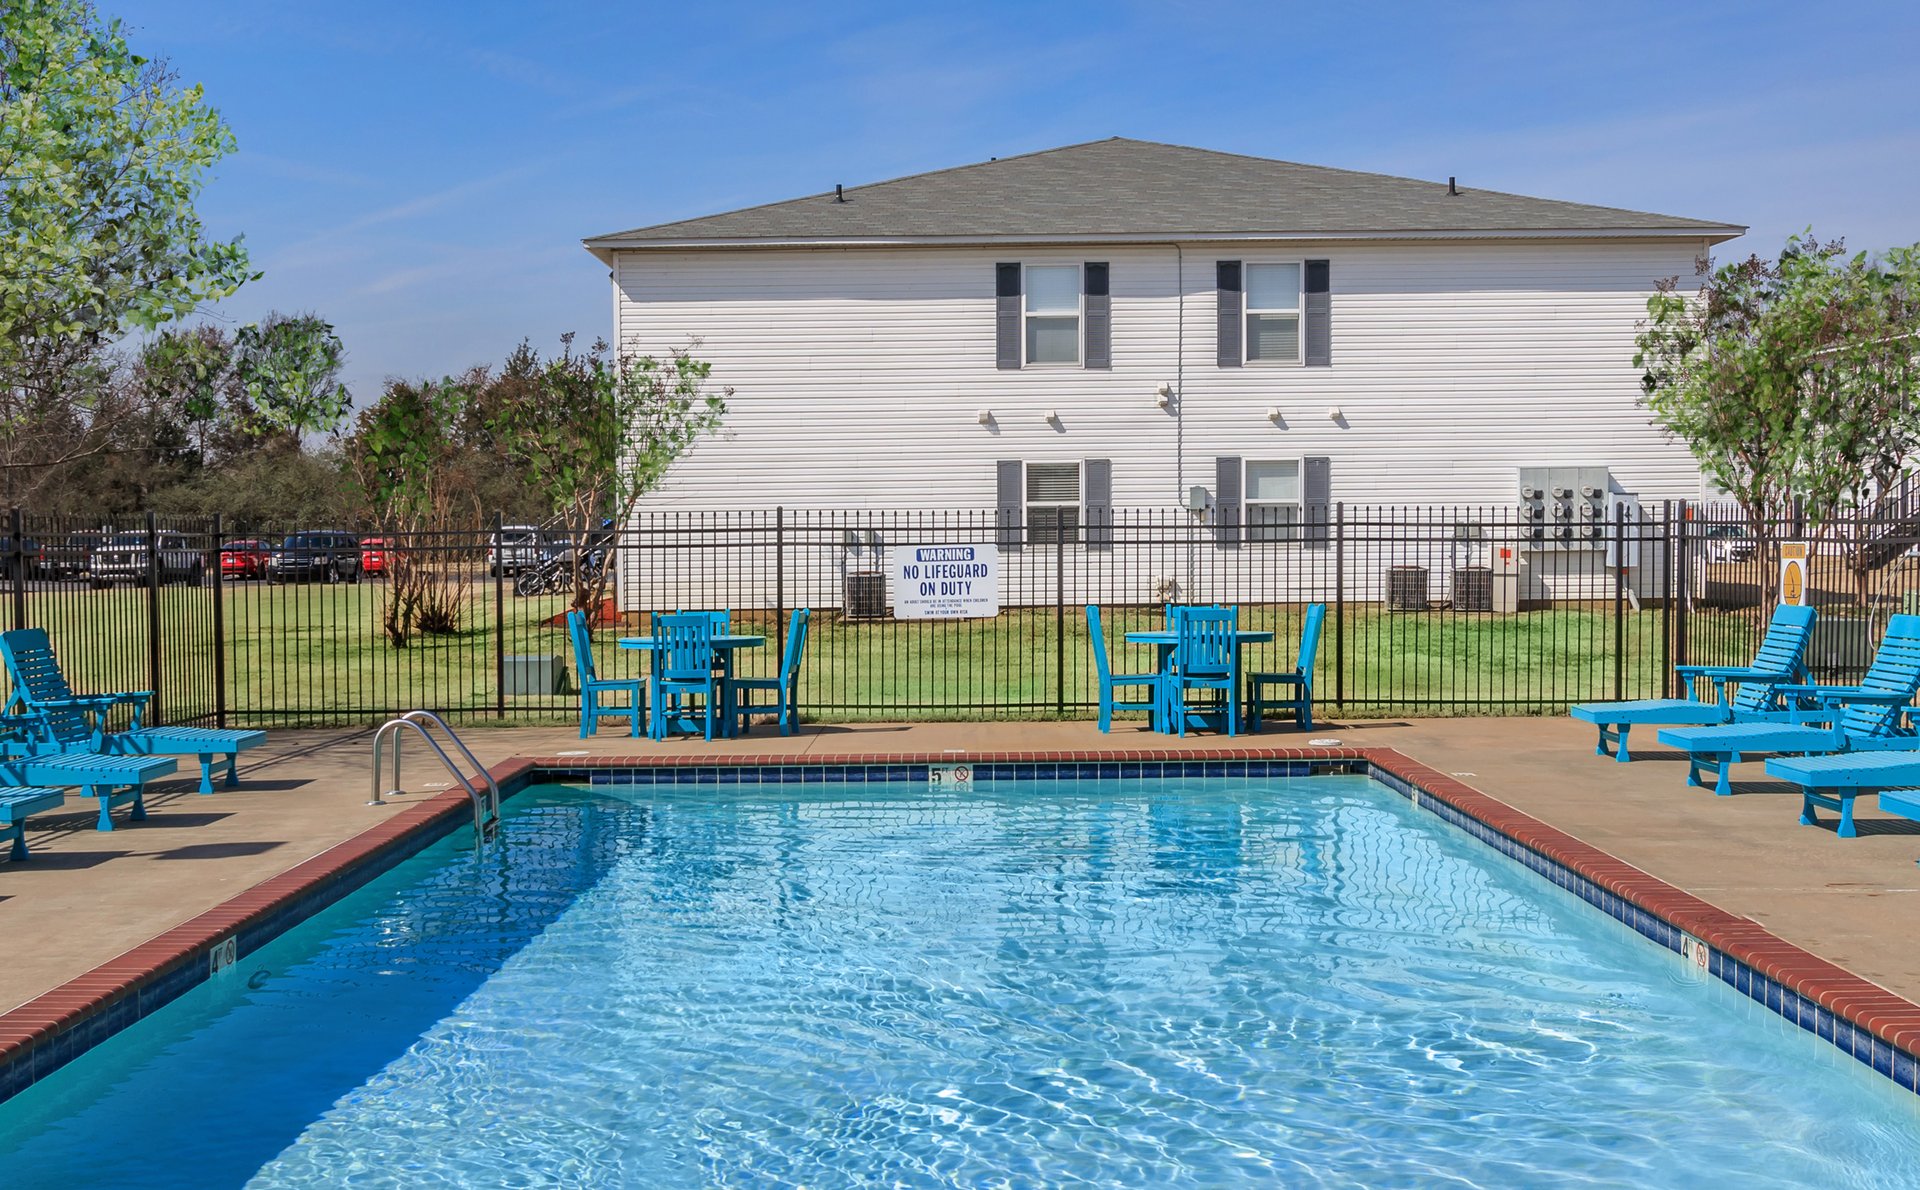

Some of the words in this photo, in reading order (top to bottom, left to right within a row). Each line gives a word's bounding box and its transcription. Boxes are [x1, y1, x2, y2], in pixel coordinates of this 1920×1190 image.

[920, 548, 971, 561] WARNING
[903, 565, 919, 579] NO
[925, 564, 988, 579] LIFEGUARD
[920, 582, 936, 596] ON
[941, 581, 972, 596] DUTY
